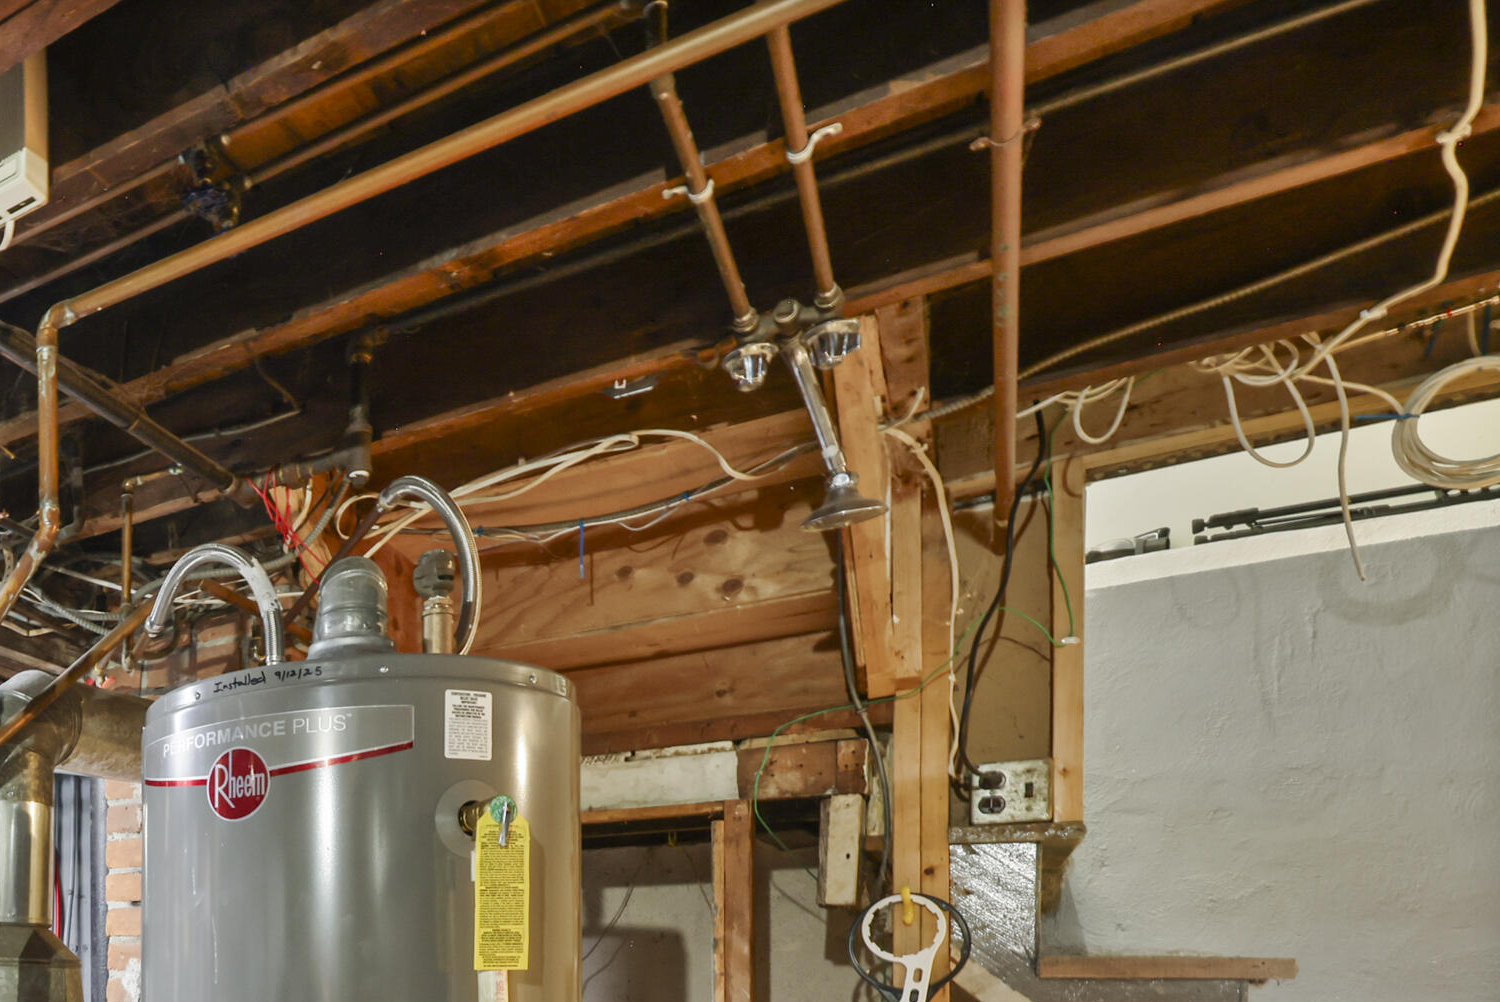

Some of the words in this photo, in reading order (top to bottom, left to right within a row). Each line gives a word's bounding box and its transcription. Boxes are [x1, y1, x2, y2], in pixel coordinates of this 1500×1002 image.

[213, 671, 266, 693] Installed
[274, 666, 322, 681] 9/12/25
[163, 720, 286, 758] PERFORMANCE
[214, 751, 265, 809] Rheem
